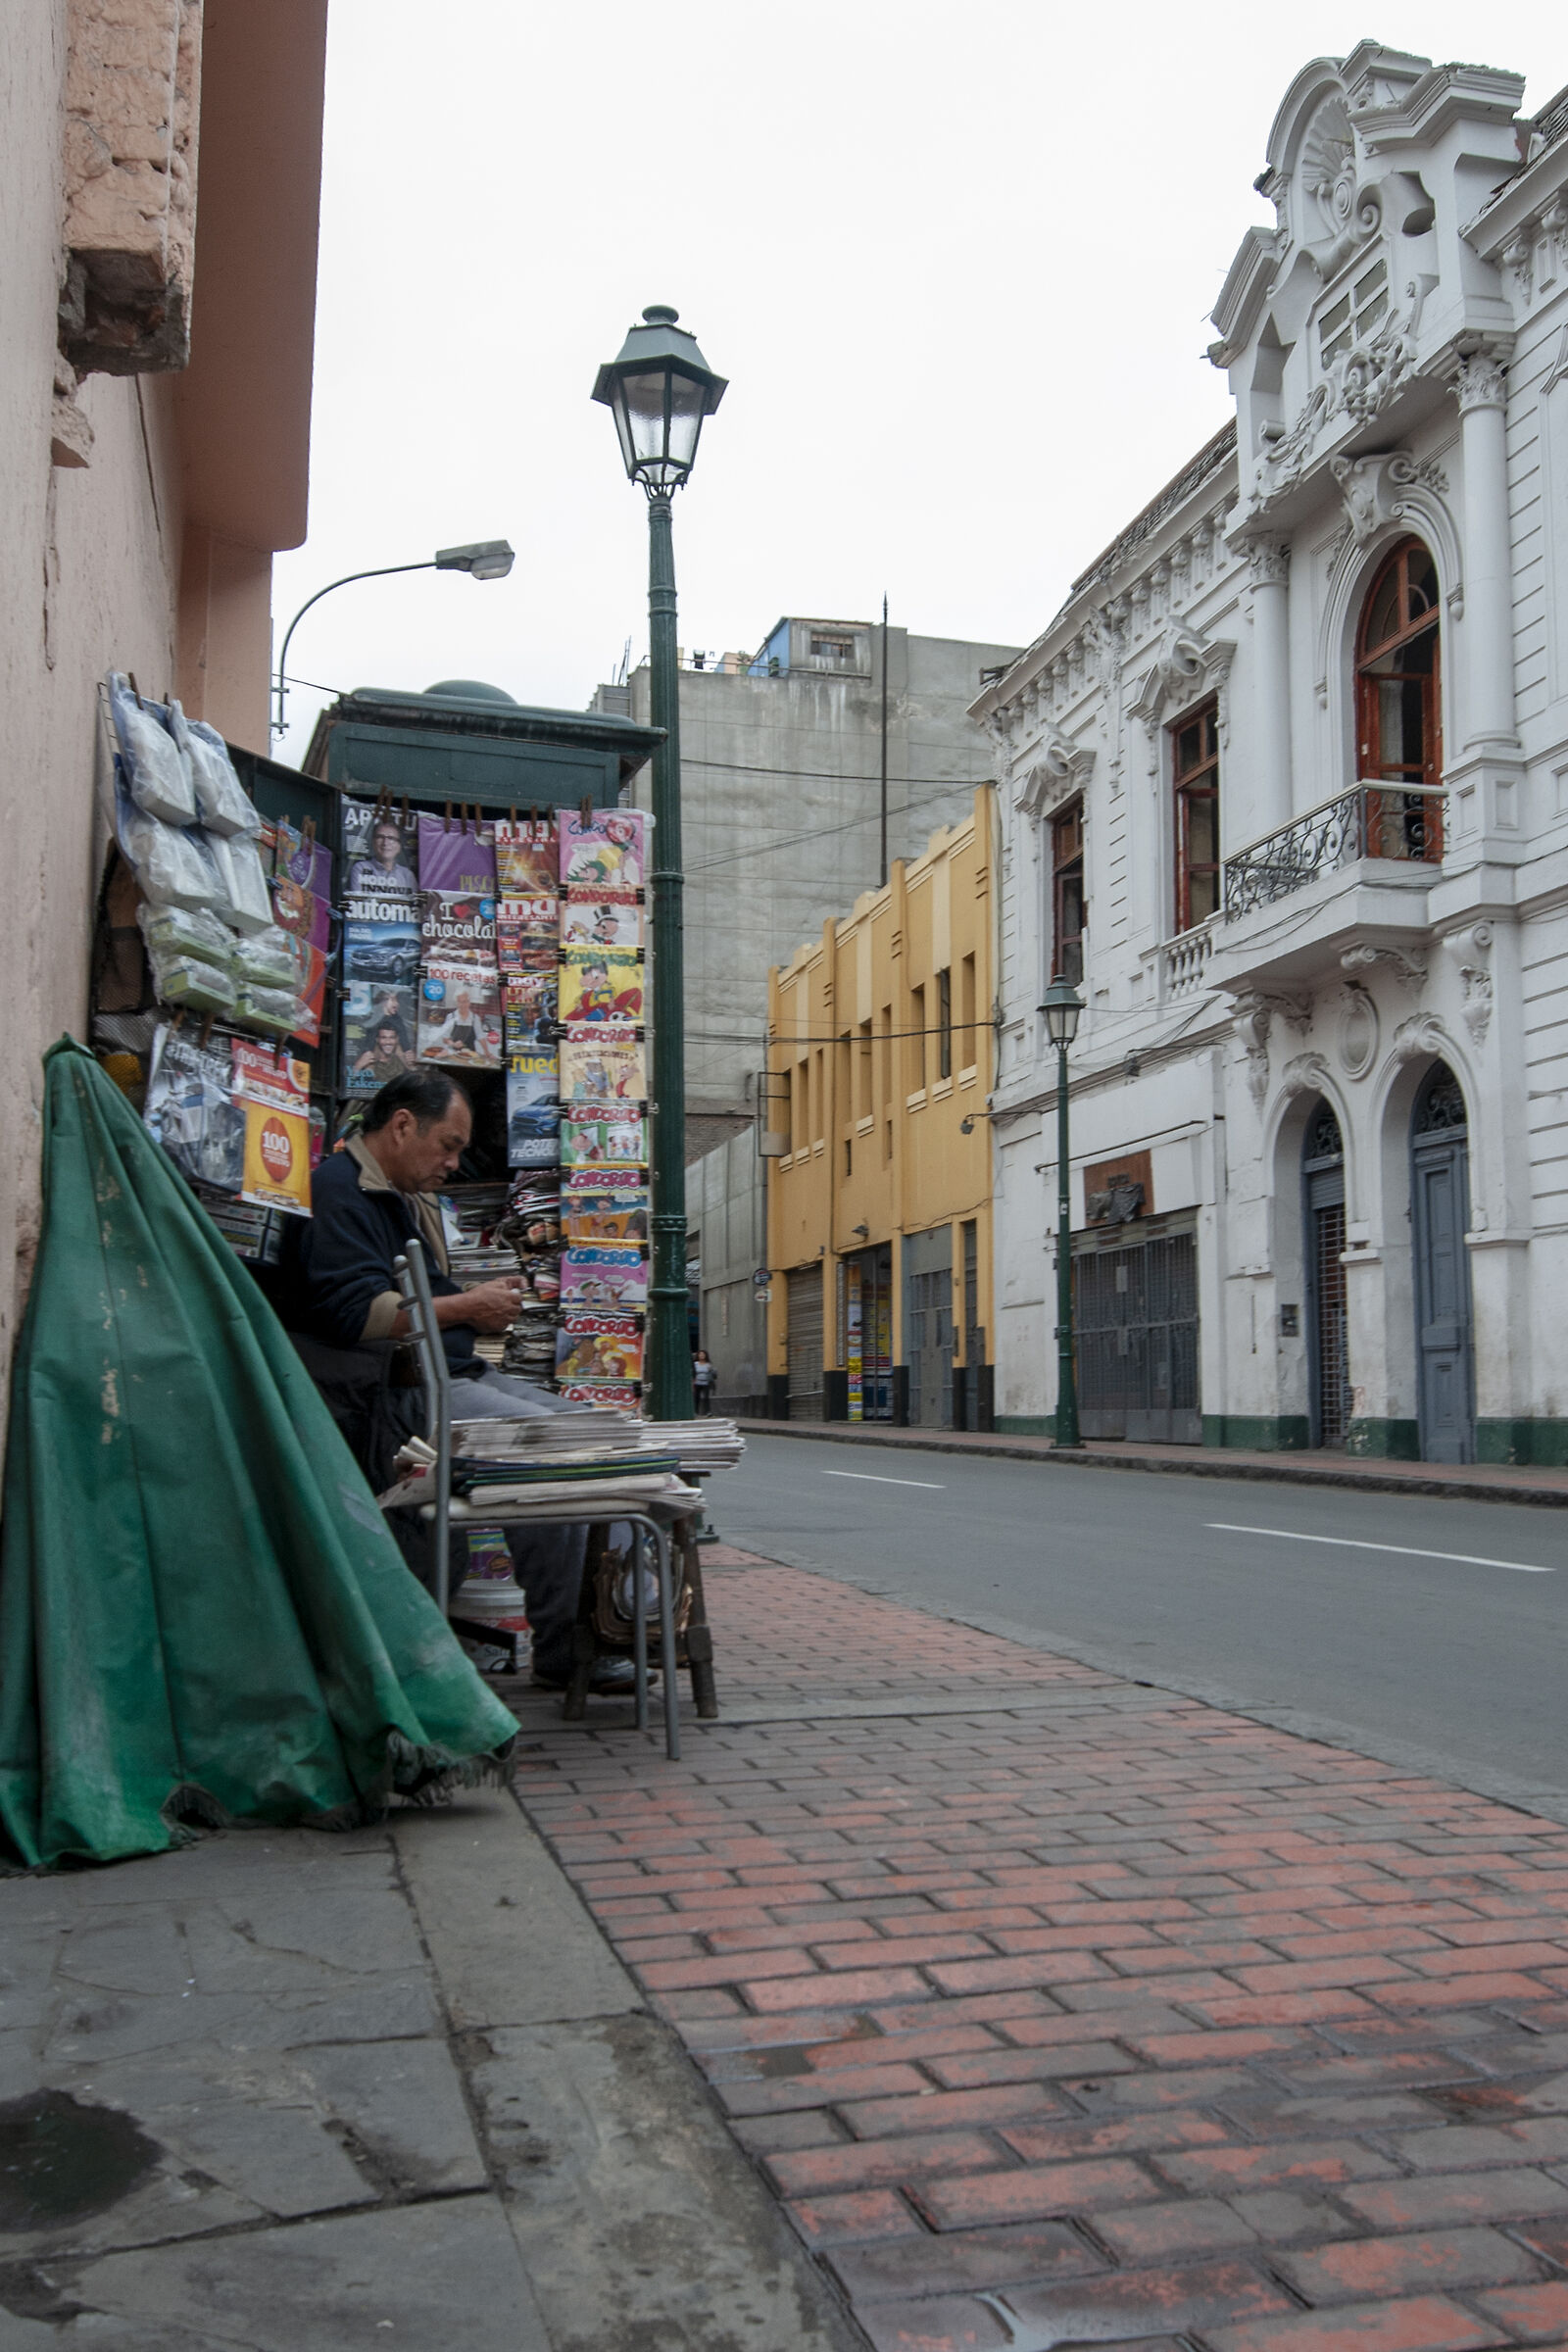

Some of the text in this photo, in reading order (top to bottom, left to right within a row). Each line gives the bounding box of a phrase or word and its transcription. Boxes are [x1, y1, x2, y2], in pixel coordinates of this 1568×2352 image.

[566, 887, 638, 906] CONDORITO
[439, 902, 454, 920] I
[565, 951, 637, 967] CONDORITO
[429, 968, 496, 985] 100 recetas
[566, 1026, 637, 1044] CONDORITO
[567, 1105, 642, 1124] CONDORITO
[263, 1131, 290, 1153] 100
[568, 1169, 641, 1189] CONDORITO
[565, 1247, 642, 1268] CONDORITO
[564, 1315, 637, 1338] CONDORITO
[561, 1384, 637, 1404] CONDORITO
